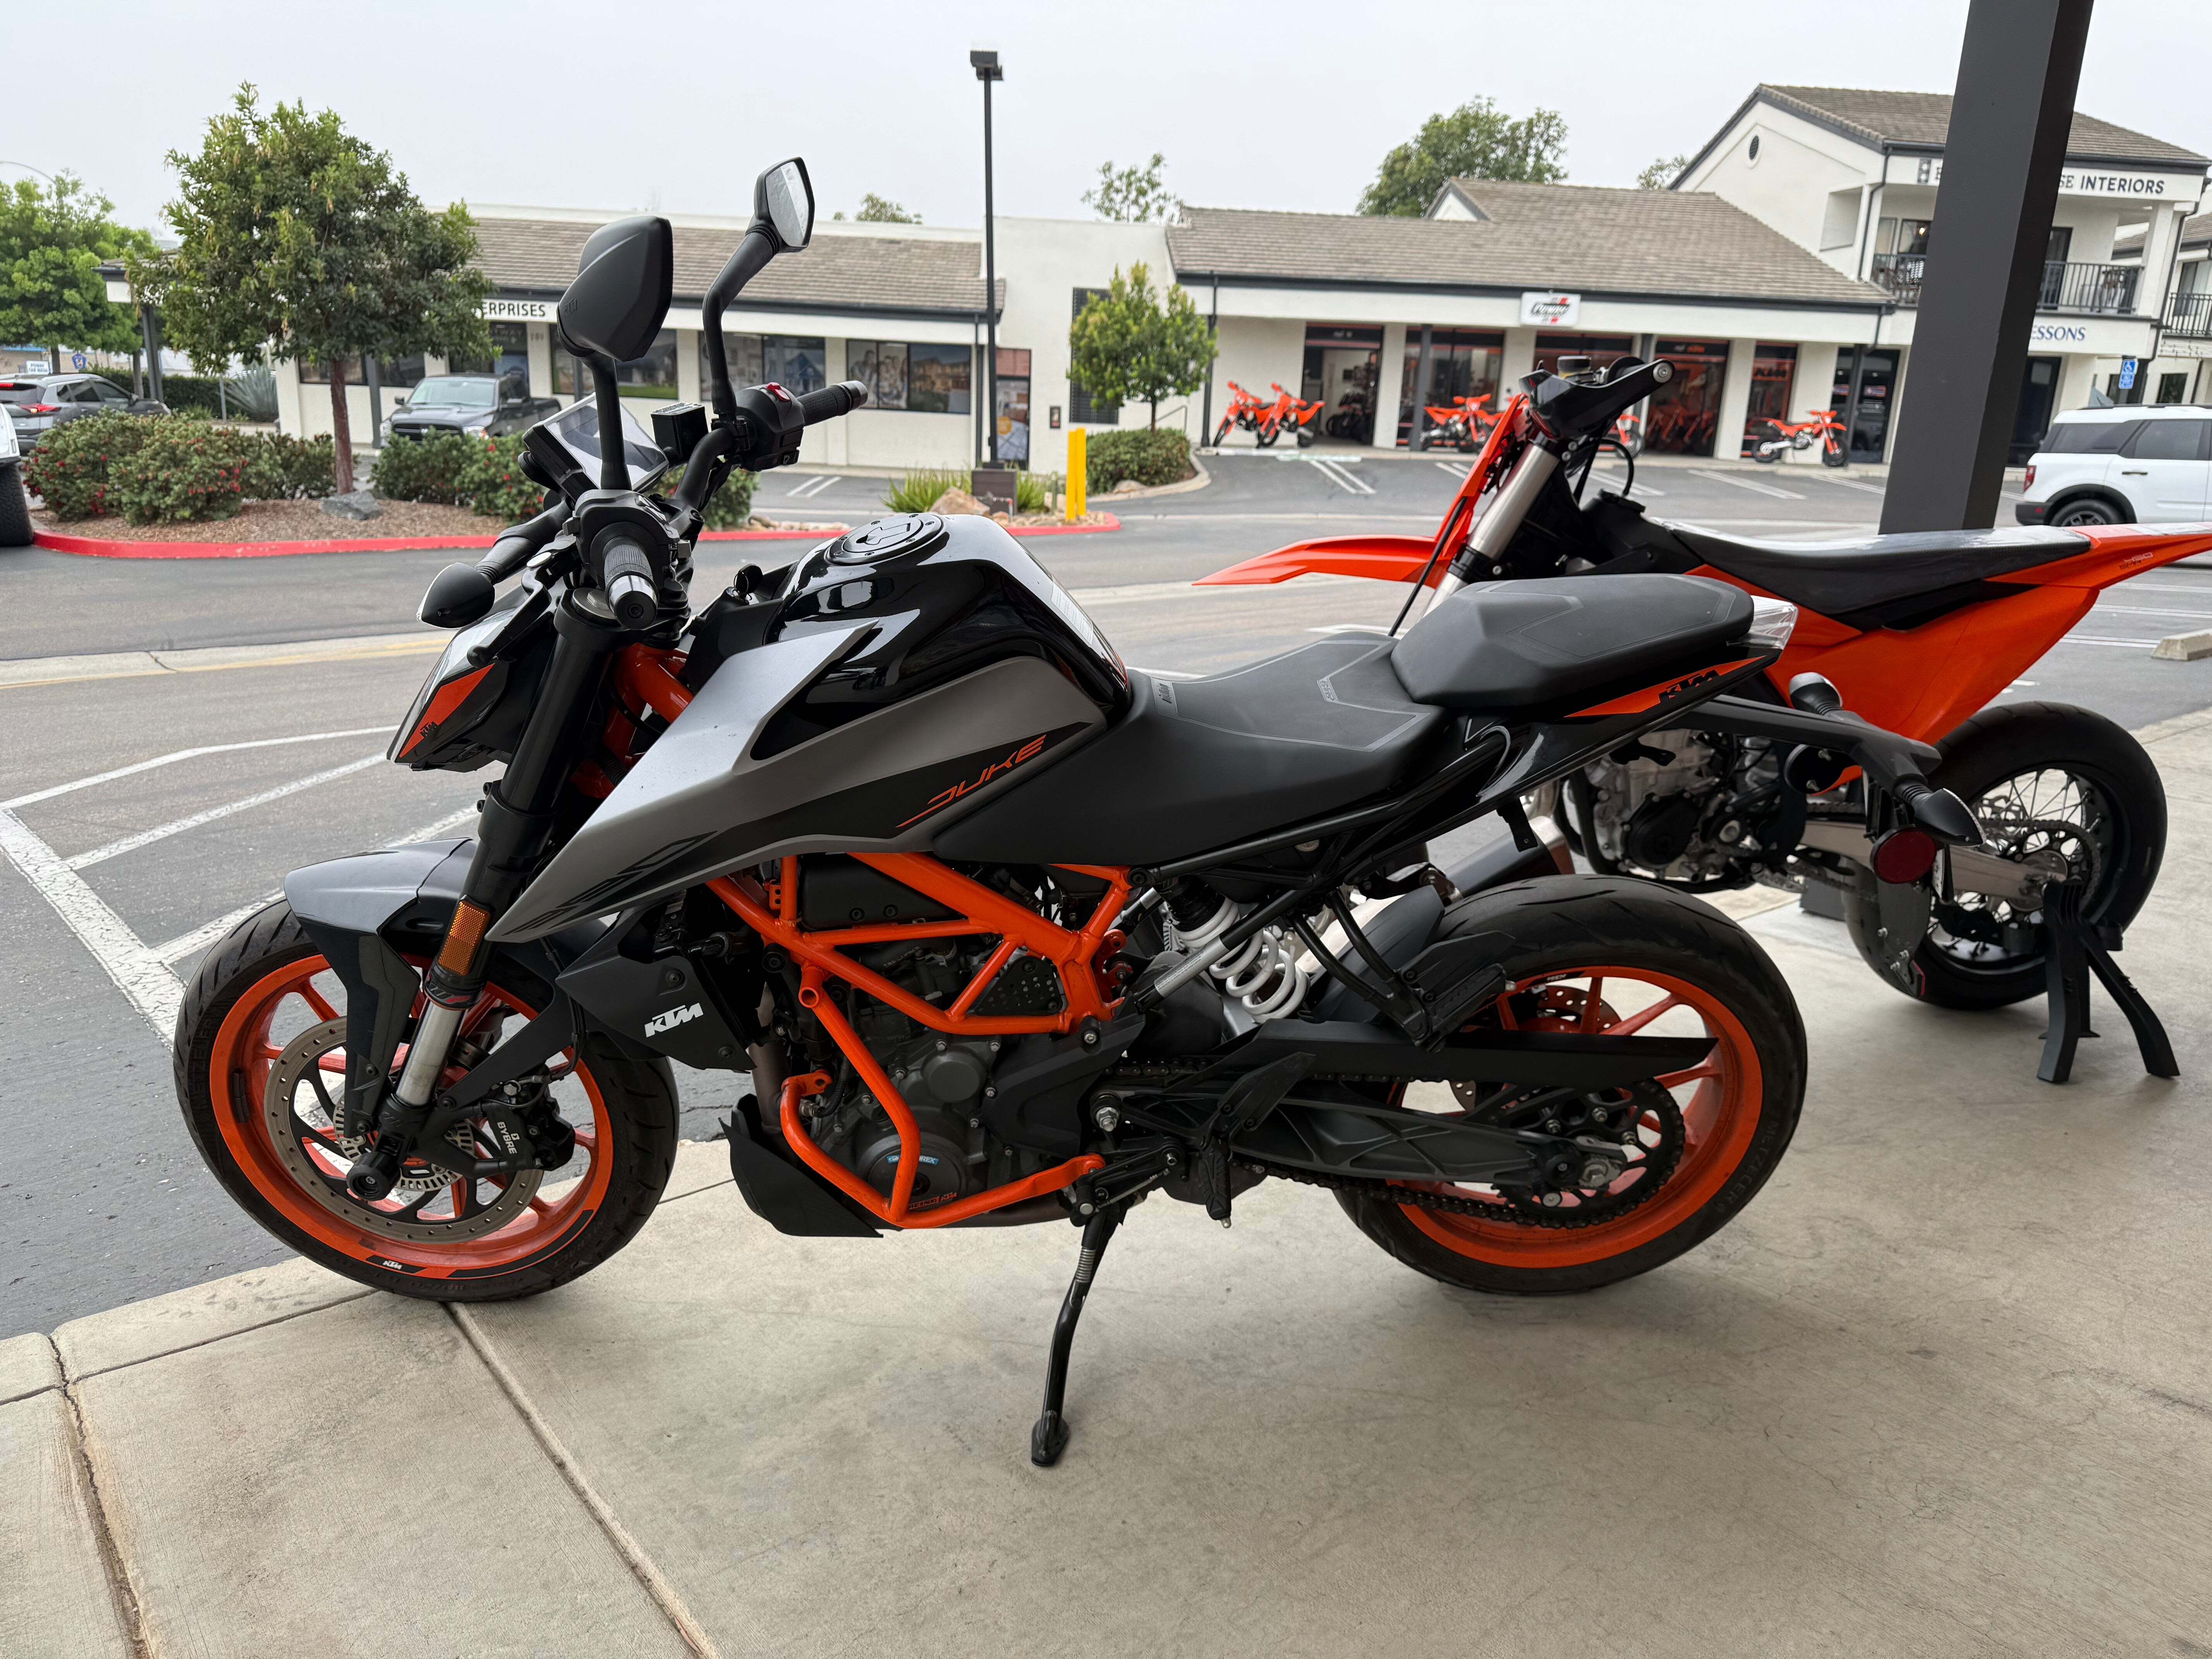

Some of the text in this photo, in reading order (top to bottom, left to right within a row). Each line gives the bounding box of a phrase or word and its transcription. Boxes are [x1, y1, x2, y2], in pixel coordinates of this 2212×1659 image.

[2080, 175, 2165, 194] INTERIORS
[482, 302, 545, 317] ERPRISES
[2030, 325, 2086, 342] ESSONS
[1659, 669, 1720, 703] KTM
[895, 734, 1046, 828] DUKE
[644, 1002, 704, 1038] KTM
[497, 1121, 518, 1154] BYBRE
